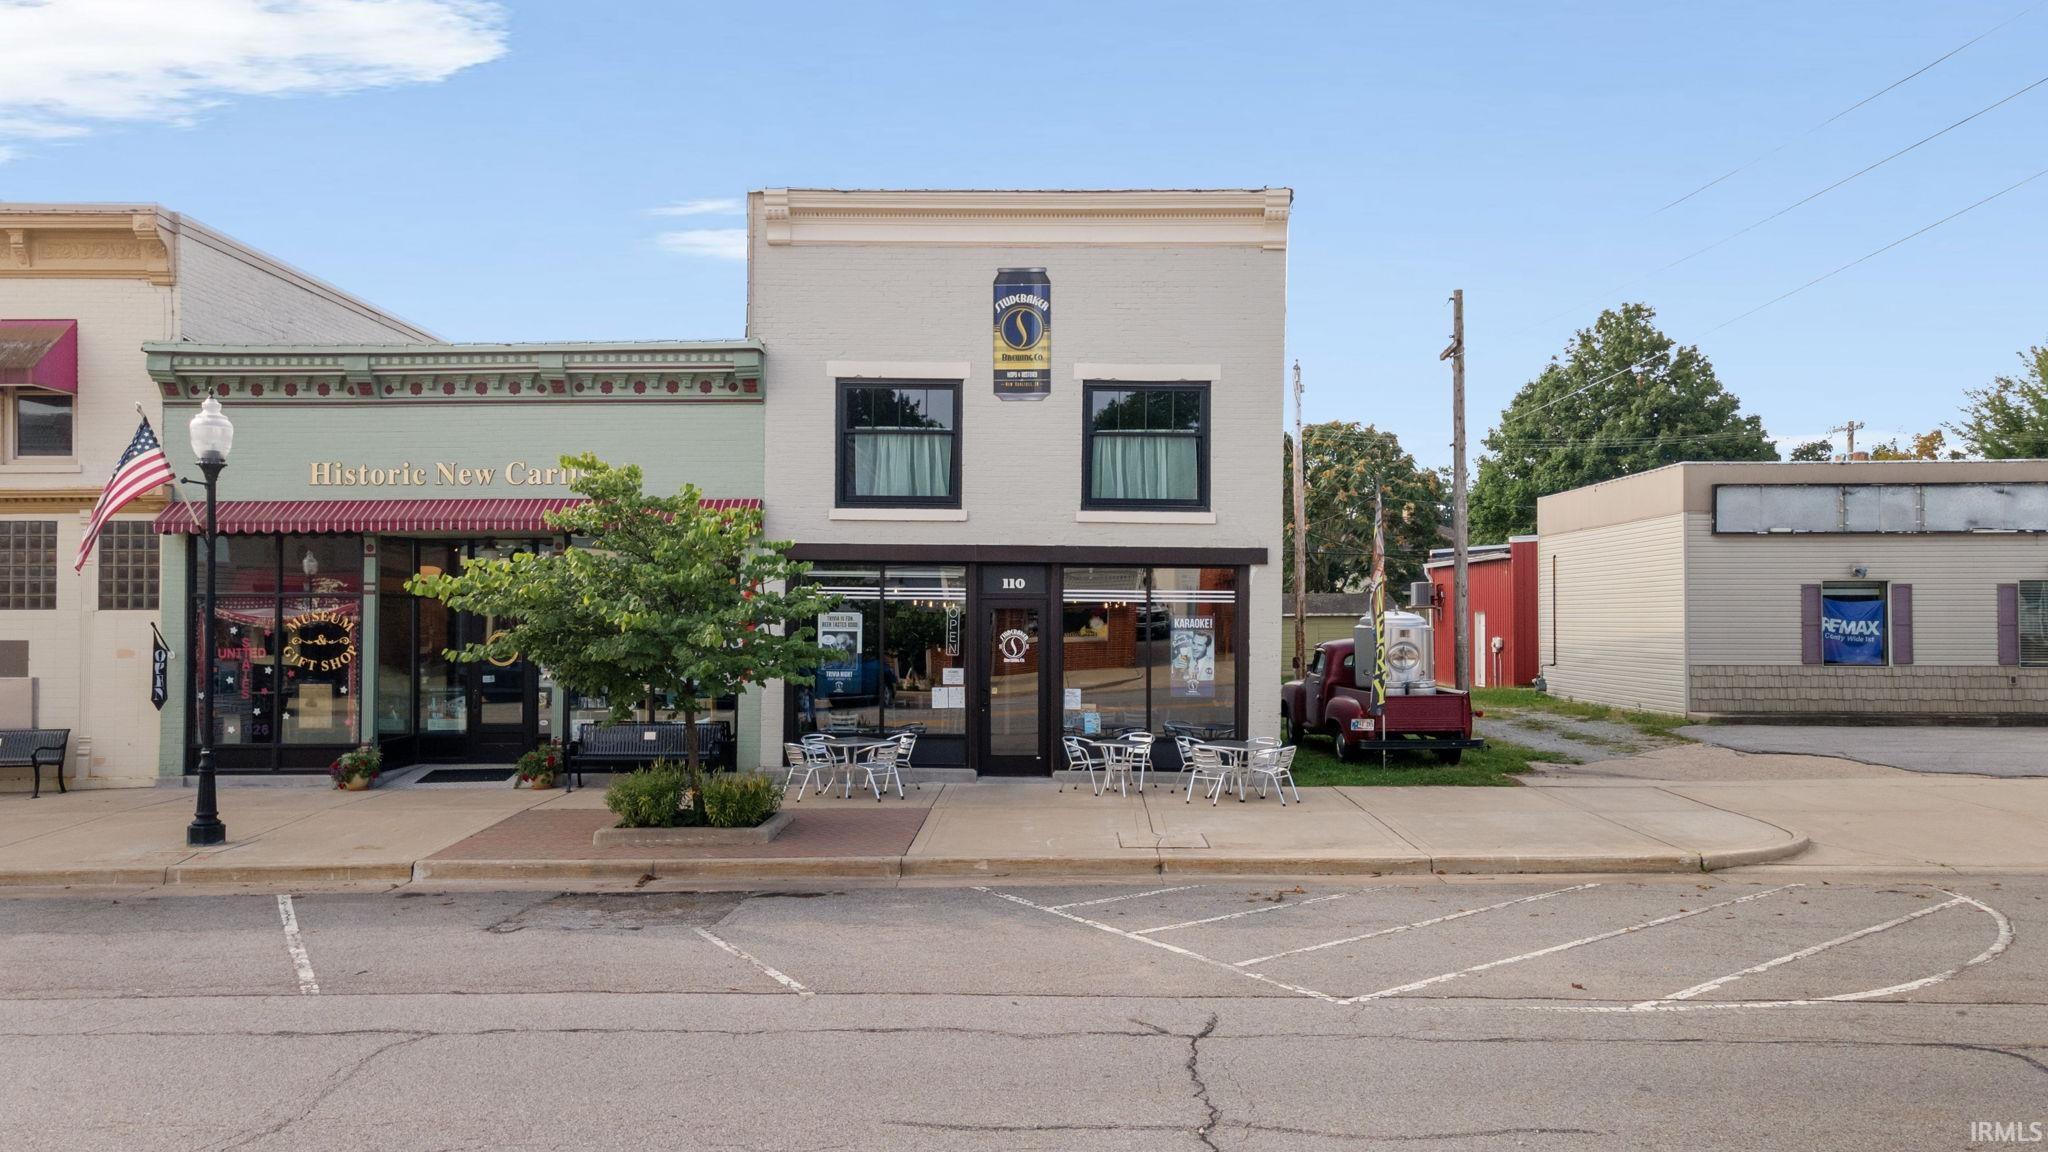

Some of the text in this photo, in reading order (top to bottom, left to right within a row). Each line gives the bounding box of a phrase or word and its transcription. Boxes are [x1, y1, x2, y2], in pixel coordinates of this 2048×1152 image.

[995, 293, 1049, 313] STUDEBAKER
[309, 461, 427, 486] Historic
[435, 461, 496, 486] New
[1002, 578, 1026, 589] 110
[286, 610, 354, 632] MUSEUM
[948, 607, 958, 653] OPEN
[1174, 618, 1213, 628] KARAOKE!
[318, 634, 326, 645] &
[217, 647, 266, 659] UNITED
[284, 645, 357, 671] GIFT SHOP
[154, 649, 166, 700] OPEN
